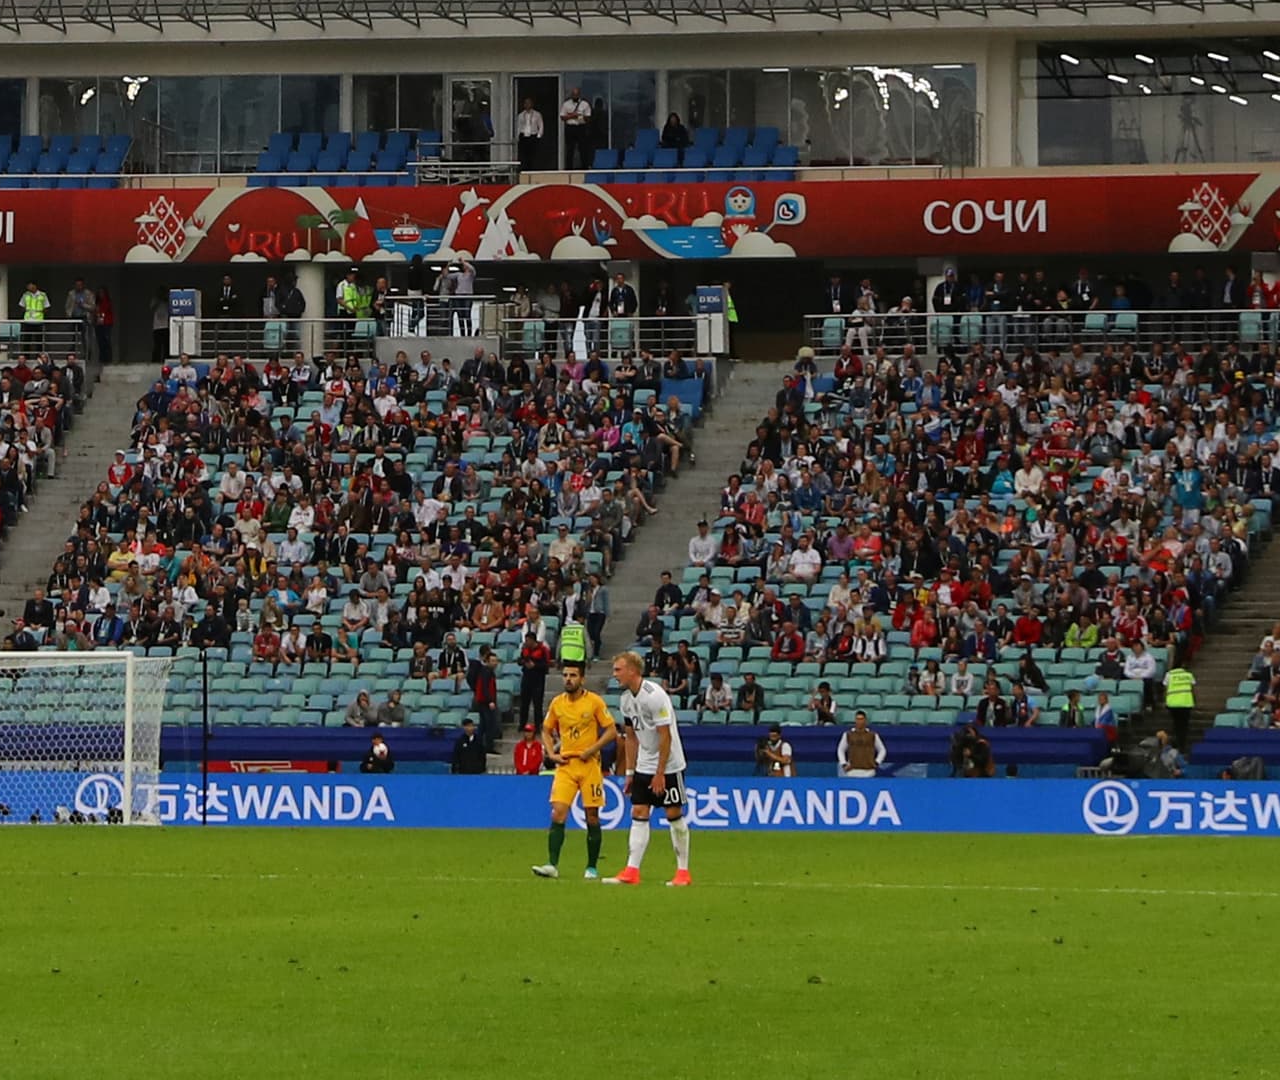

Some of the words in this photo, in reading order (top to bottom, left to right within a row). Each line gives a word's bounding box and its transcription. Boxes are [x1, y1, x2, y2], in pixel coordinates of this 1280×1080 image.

[923, 199, 1047, 234] СОЧИ
[231, 785, 395, 821] WANDA
[591, 783, 602, 797] 16
[663, 787, 680, 805] 20
[732, 789, 901, 825] WANDA
